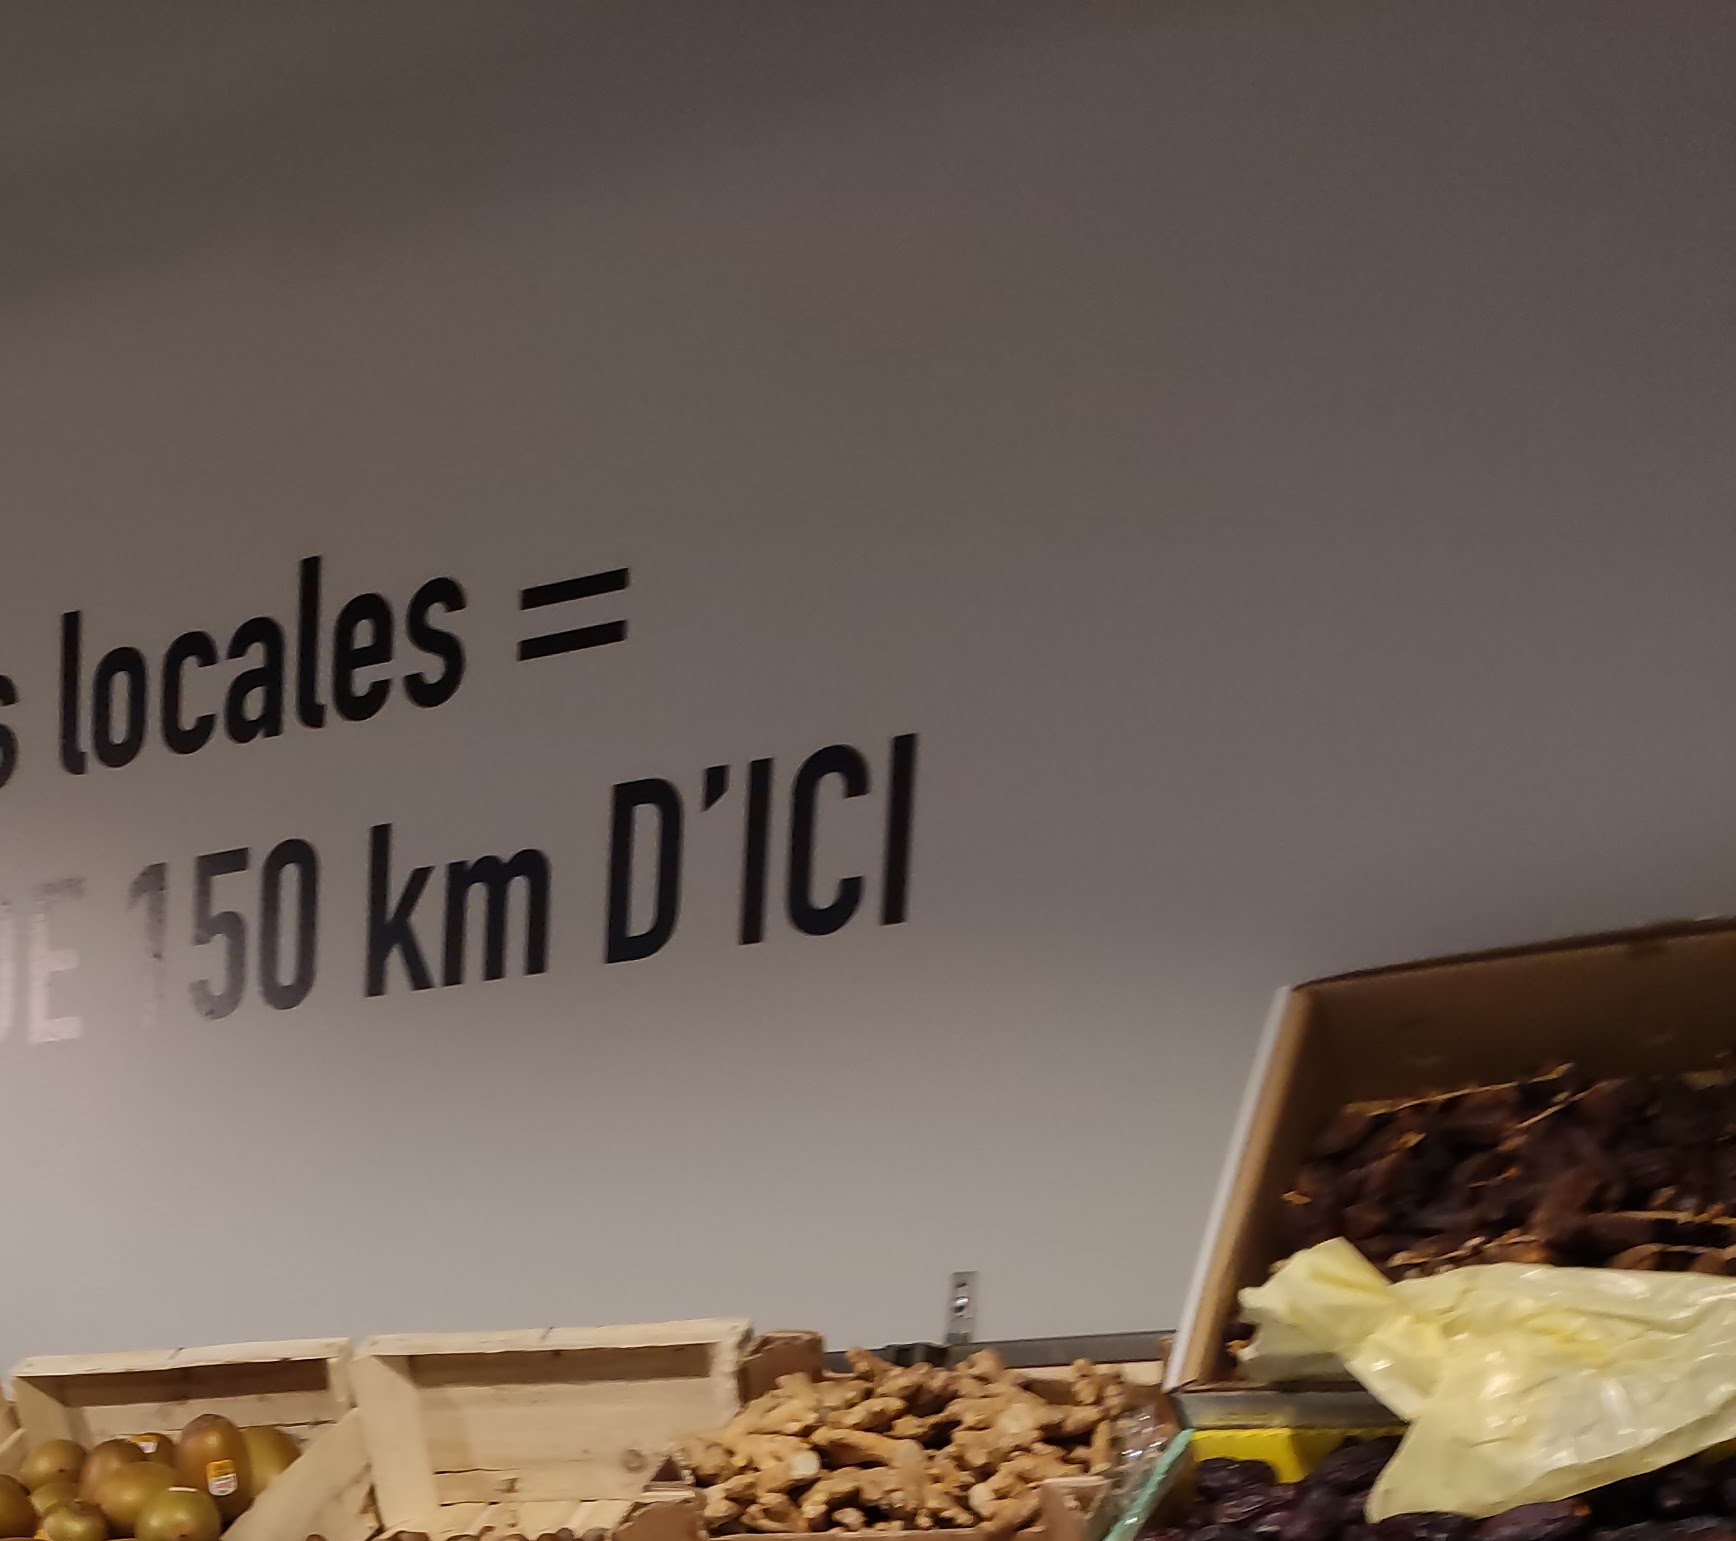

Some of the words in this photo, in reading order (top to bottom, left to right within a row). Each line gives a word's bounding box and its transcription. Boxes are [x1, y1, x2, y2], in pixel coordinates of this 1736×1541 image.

[58, 555, 468, 775] locales
[517, 566, 630, 662] =
[124, 837, 320, 1036] 150
[364, 822, 552, 998] km
[602, 731, 920, 966] D'ICI
